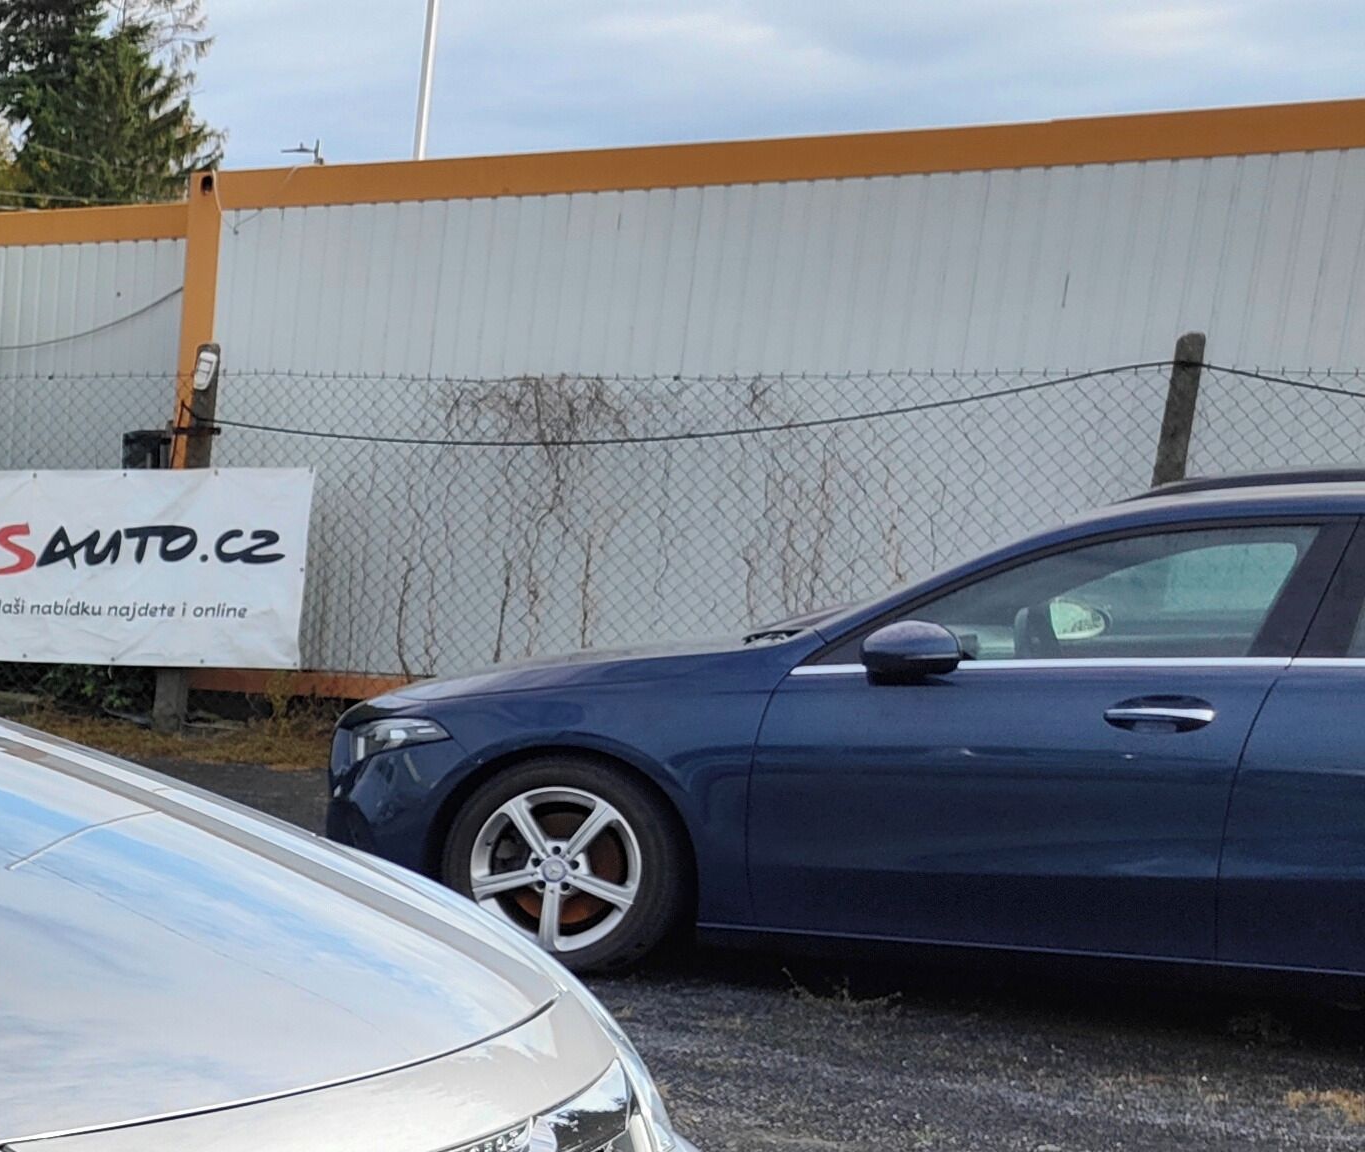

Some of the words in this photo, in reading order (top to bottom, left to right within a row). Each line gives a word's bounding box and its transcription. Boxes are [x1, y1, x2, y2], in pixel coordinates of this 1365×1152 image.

[30, 598, 102, 617] nabídku
[107, 602, 175, 622] najdete
[180, 602, 187, 617] i
[192, 602, 248, 619] online
